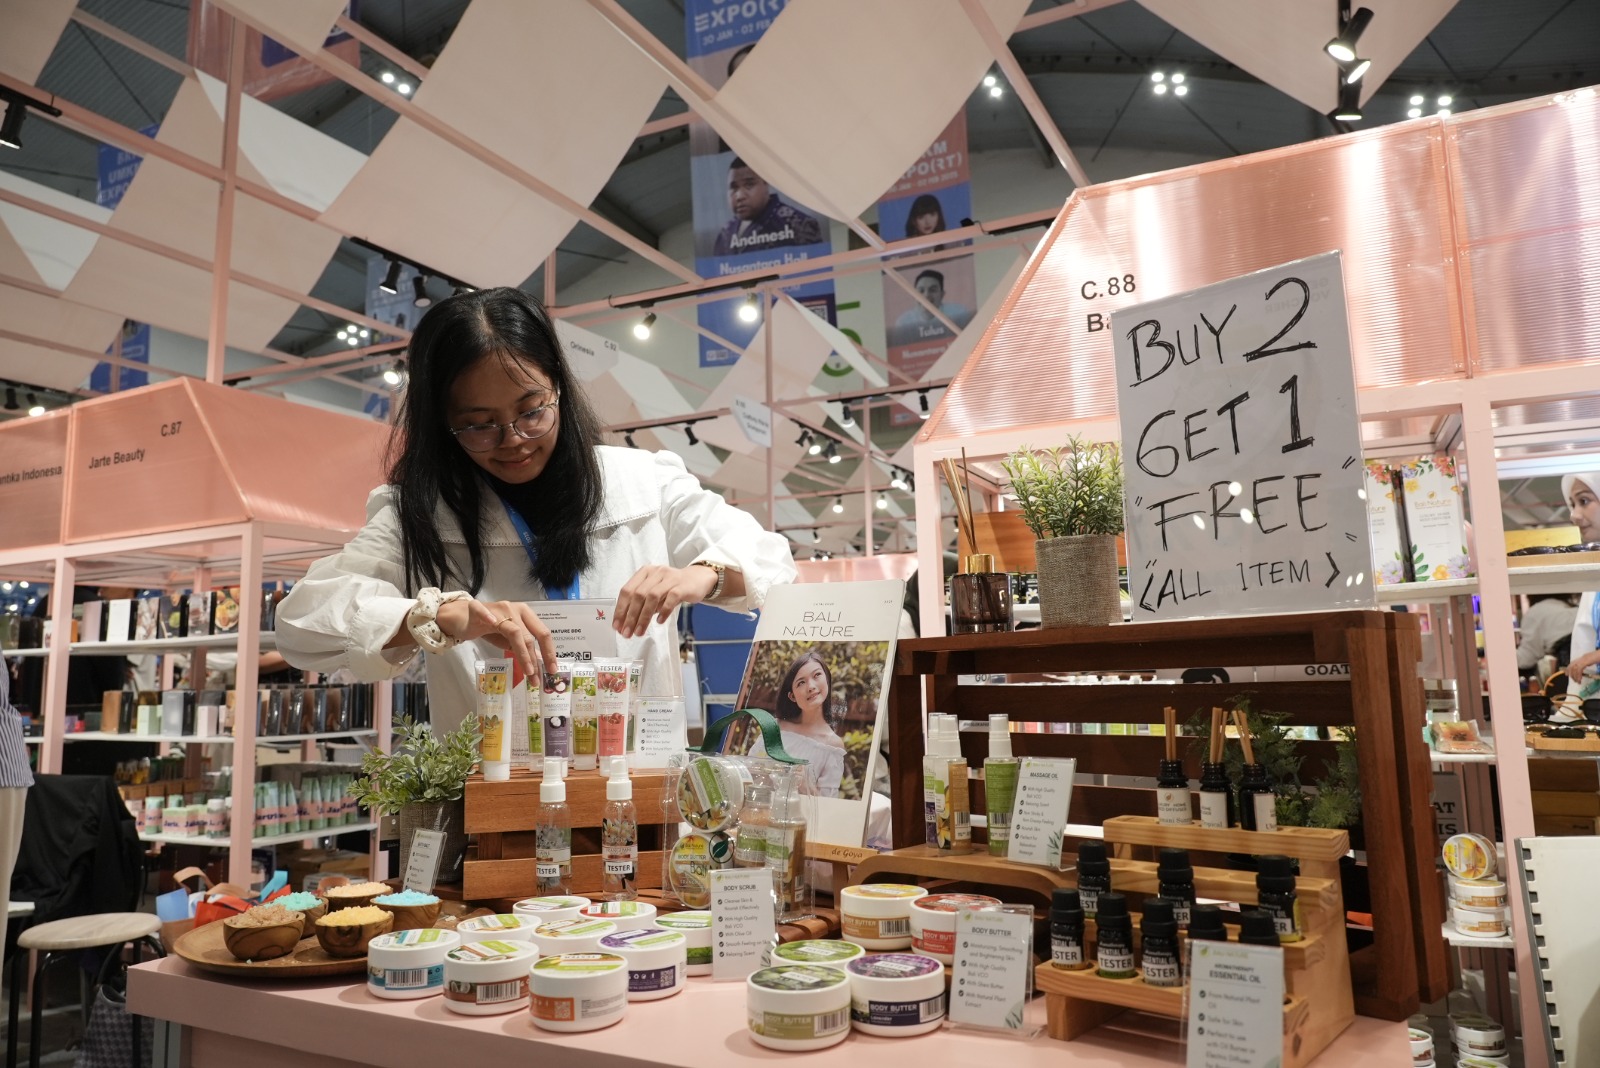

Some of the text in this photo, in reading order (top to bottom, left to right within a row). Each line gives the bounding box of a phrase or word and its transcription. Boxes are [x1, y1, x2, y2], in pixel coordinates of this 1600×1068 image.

[716, 30, 733, 41] JAN
[741, 23, 753, 35] 02
[730, 225, 794, 248] Andmesh
[1081, 274, 1136, 300] C.88
[1087, 313, 1111, 332] B
[919, 326, 944, 338] Tulus
[1127, 277, 1317, 388] BUY 2
[161, 421, 182, 437] C.87
[1136, 374, 1315, 478] GET 1
[88, 448, 145, 469] Jarte Beauty
[22, 464, 62, 480] Indonesia
[803, 611, 842, 623] BALI
[783, 626, 855, 638] NATURE
[1304, 664, 1350, 676] GOAT
[843, 849, 863, 858] Goya
[537, 867, 557, 875] TESTER
[608, 864, 631, 872] TESTER
[854, 918, 876, 926] BUTTER
[971, 926, 1012, 936] BODY BUTTER
[1052, 950, 1077, 960] ESTER
[1100, 958, 1132, 969] TESTER
[1215, 963, 1254, 972] AROMATHERAPY
[1143, 966, 1176, 978] TESTER
[1209, 970, 1261, 984] ESSENTIAL OIL
[890, 1004, 917, 1012] BUTTER
